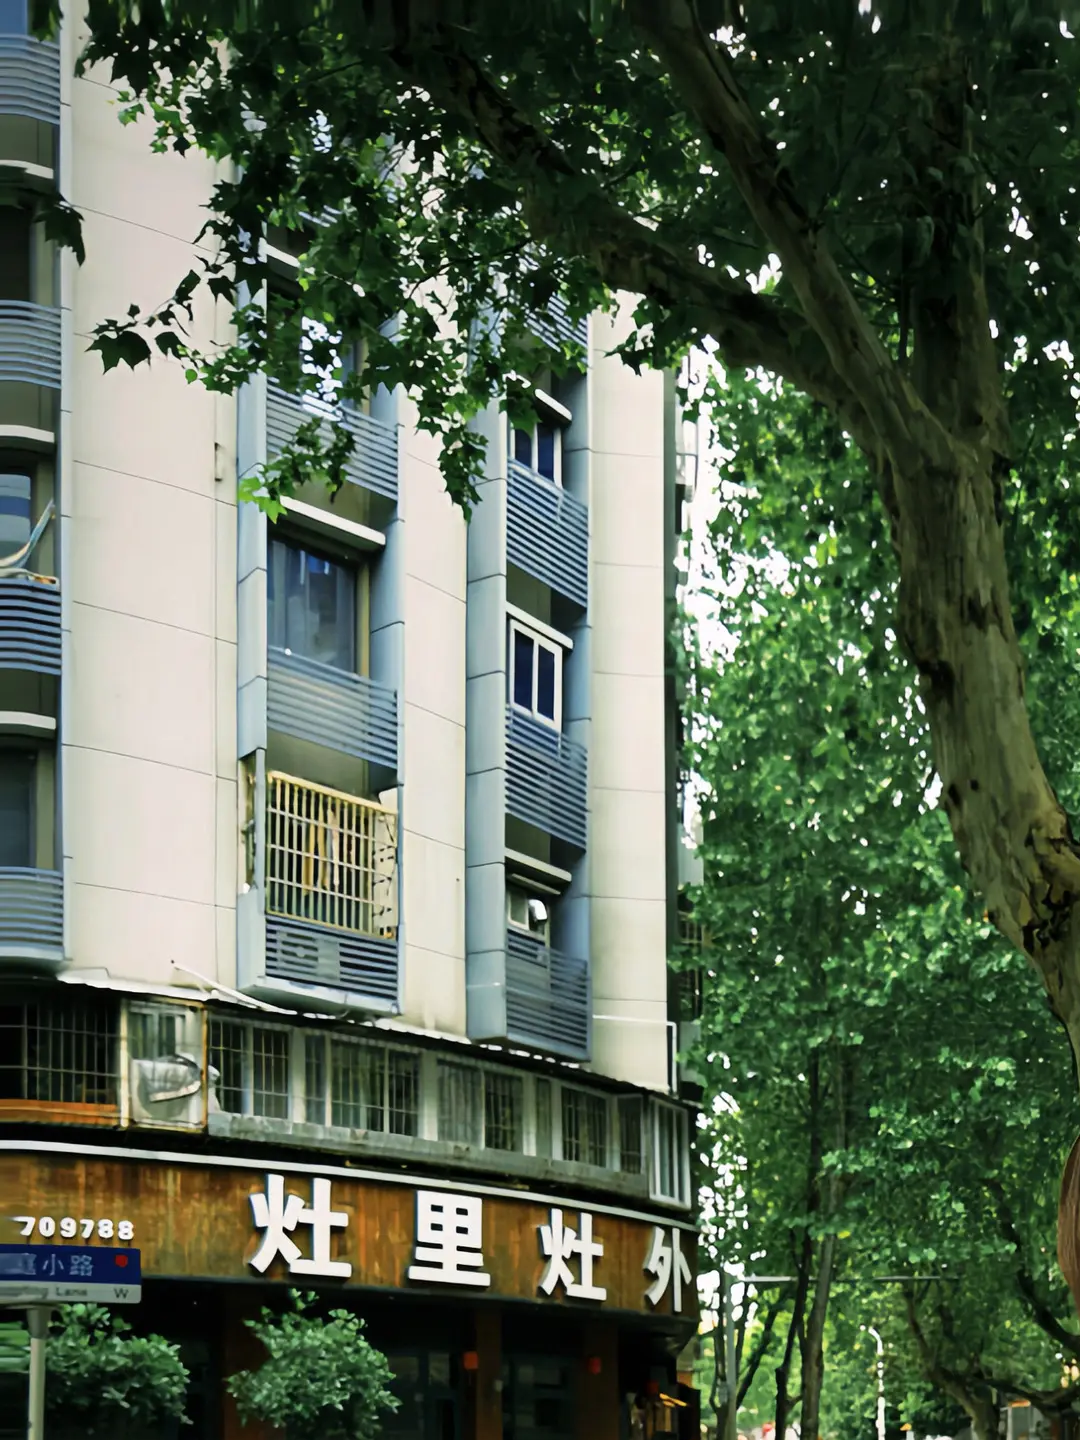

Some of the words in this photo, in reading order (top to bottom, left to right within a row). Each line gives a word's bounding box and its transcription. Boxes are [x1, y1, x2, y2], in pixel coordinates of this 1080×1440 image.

[11, 1216, 135, 1240] 709788
[249, 1173, 691, 1312] 灶里灶外
[113, 1287, 129, 1299] W
